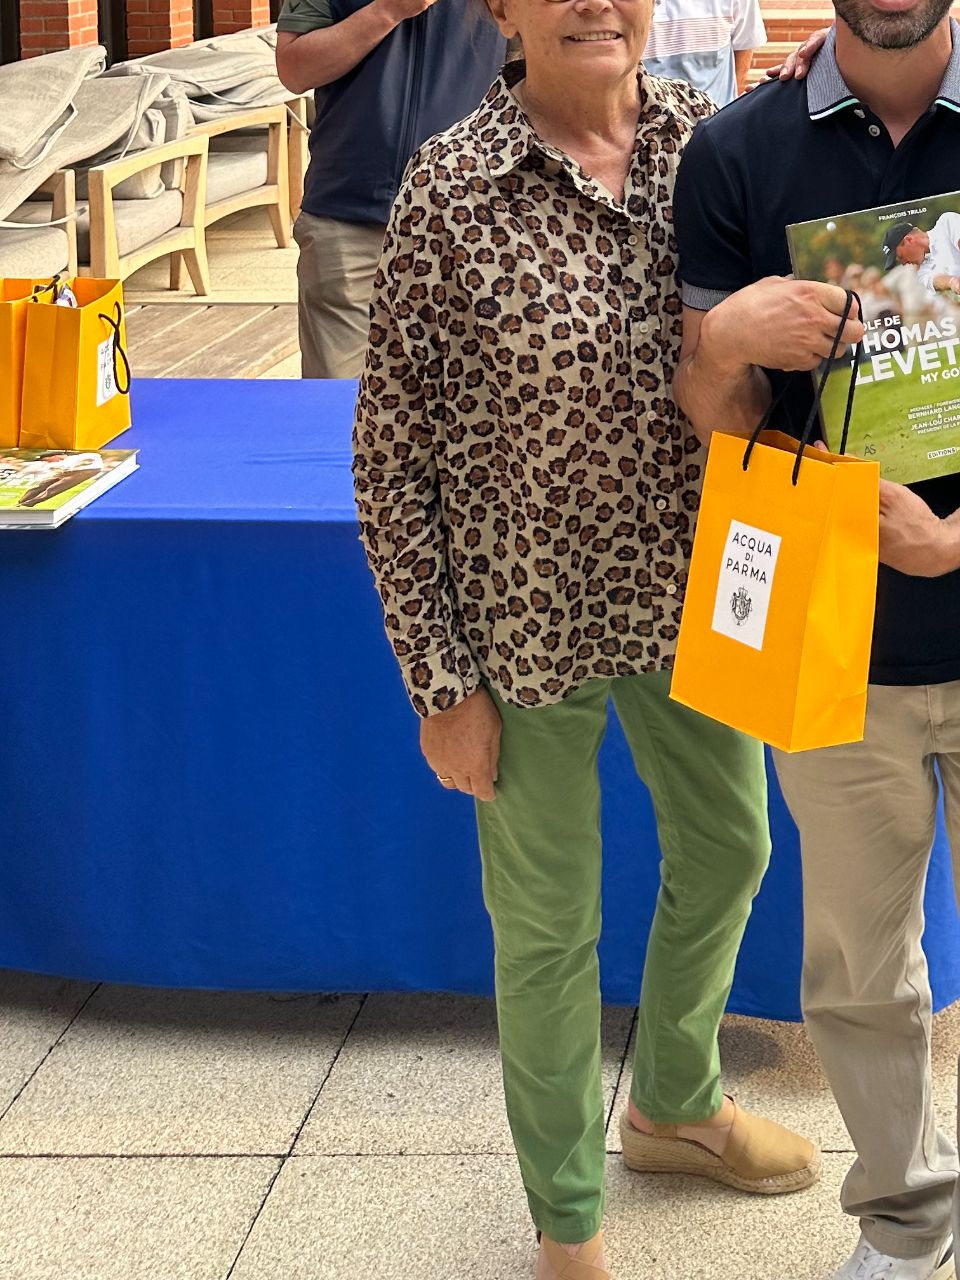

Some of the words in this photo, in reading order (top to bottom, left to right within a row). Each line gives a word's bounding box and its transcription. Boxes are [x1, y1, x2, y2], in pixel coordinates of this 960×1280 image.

[884, 315, 901, 327] DE
[850, 337, 960, 386] LEVET
[920, 371, 939, 385] MY
[732, 532, 772, 557] ACQUA
[745, 553, 754, 562] DI
[726, 557, 767, 584] PARMA
